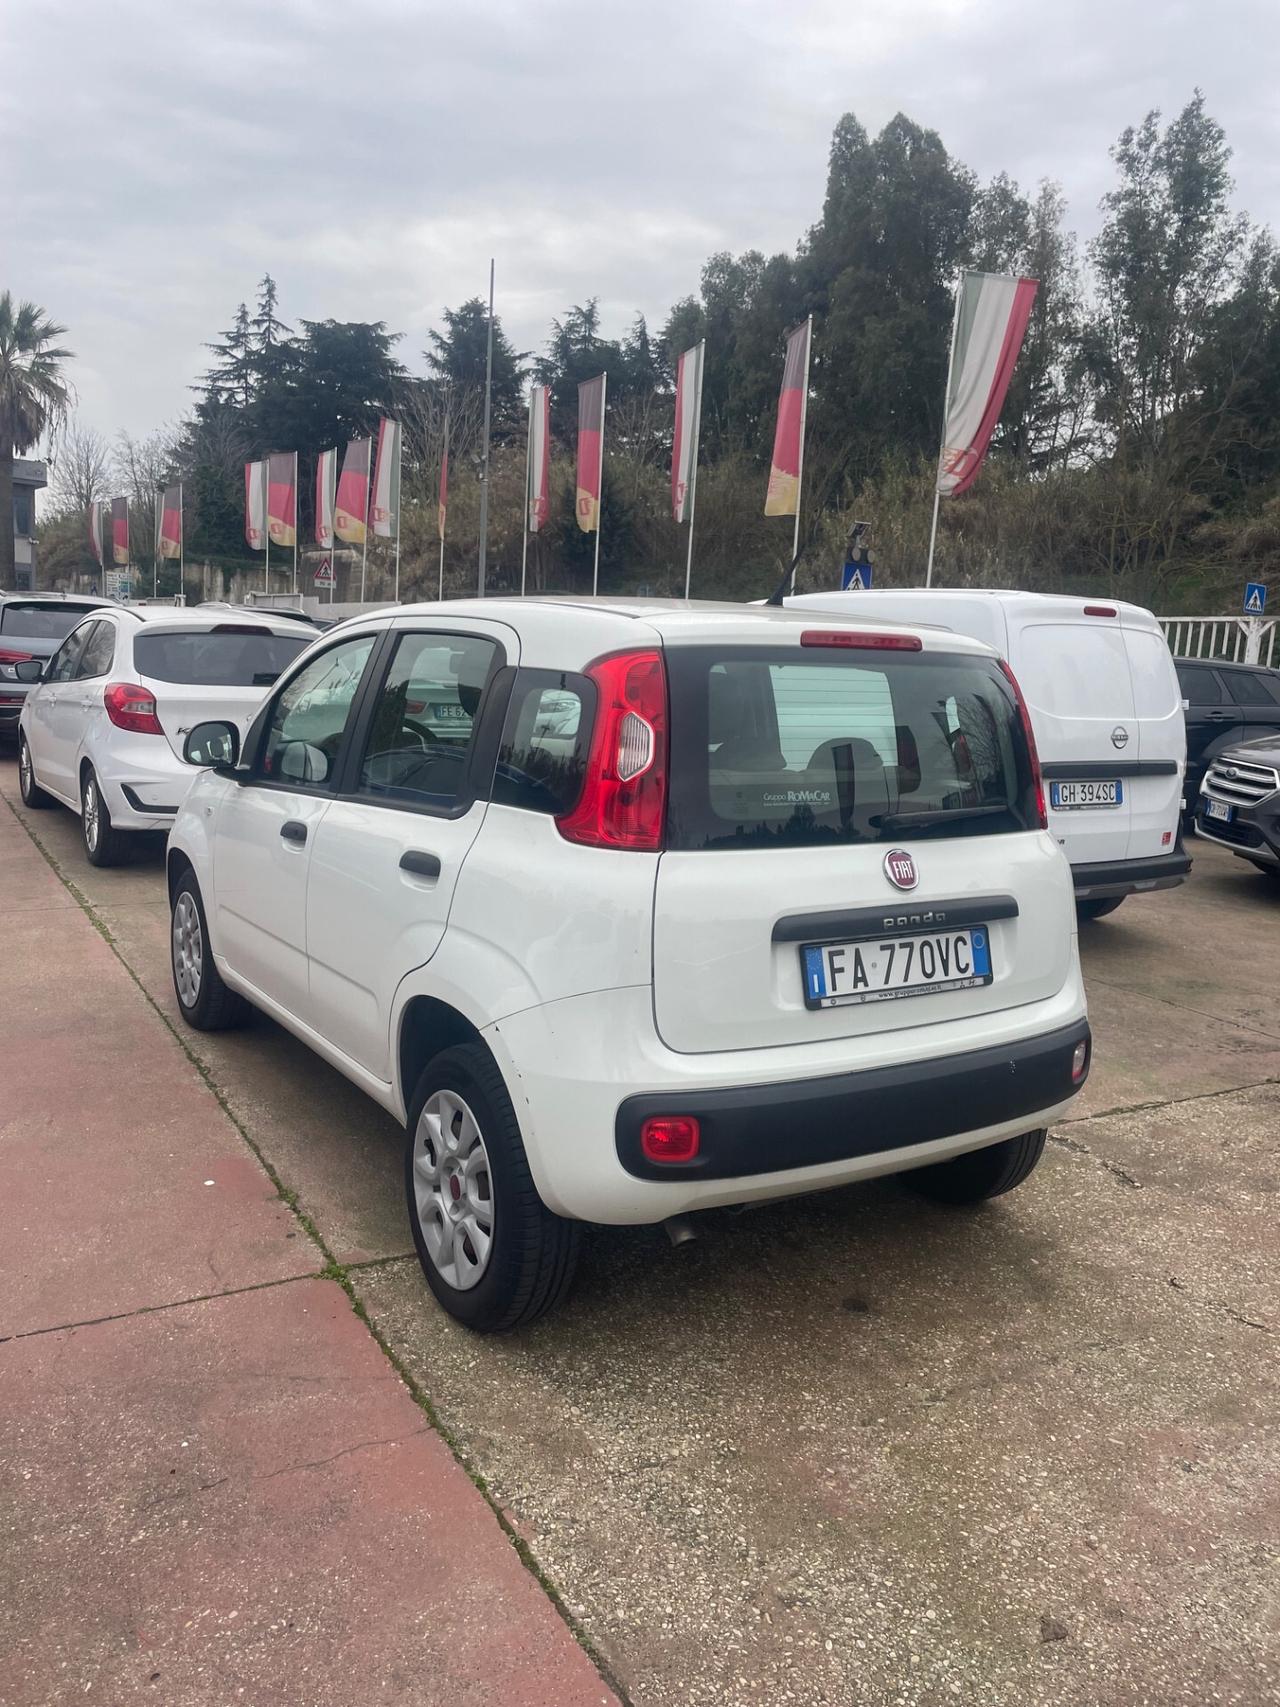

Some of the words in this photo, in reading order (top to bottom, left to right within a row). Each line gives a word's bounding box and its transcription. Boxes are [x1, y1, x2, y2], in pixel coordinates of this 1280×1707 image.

[1061, 784, 1076, 803] GH
[1080, 783, 1115, 802] 394SC
[893, 860, 914, 880] FIAT
[883, 911, 946, 929] panda
[827, 948, 869, 992] FA
[879, 935, 970, 985] 770VC
